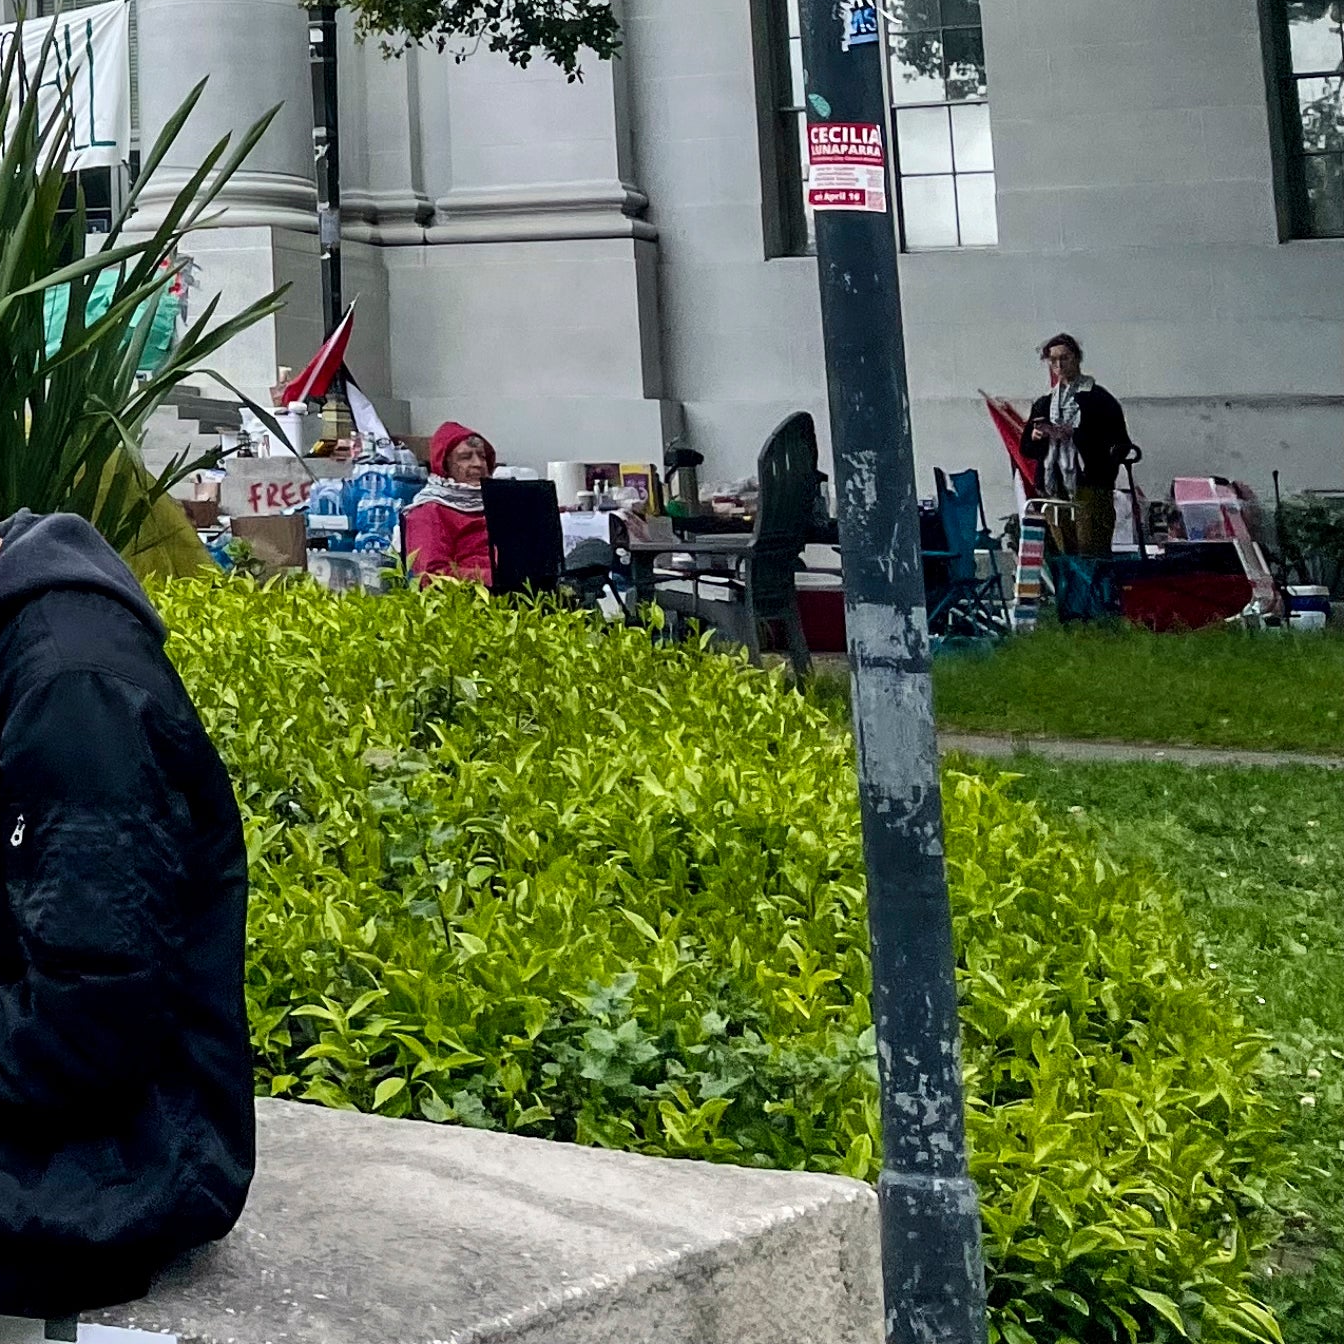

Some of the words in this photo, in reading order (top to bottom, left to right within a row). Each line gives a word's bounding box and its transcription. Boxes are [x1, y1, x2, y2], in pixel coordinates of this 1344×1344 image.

[35, 18, 117, 152] ALL
[810, 127, 879, 144] CECILIA
[811, 144, 881, 156] LUNAPARRA
